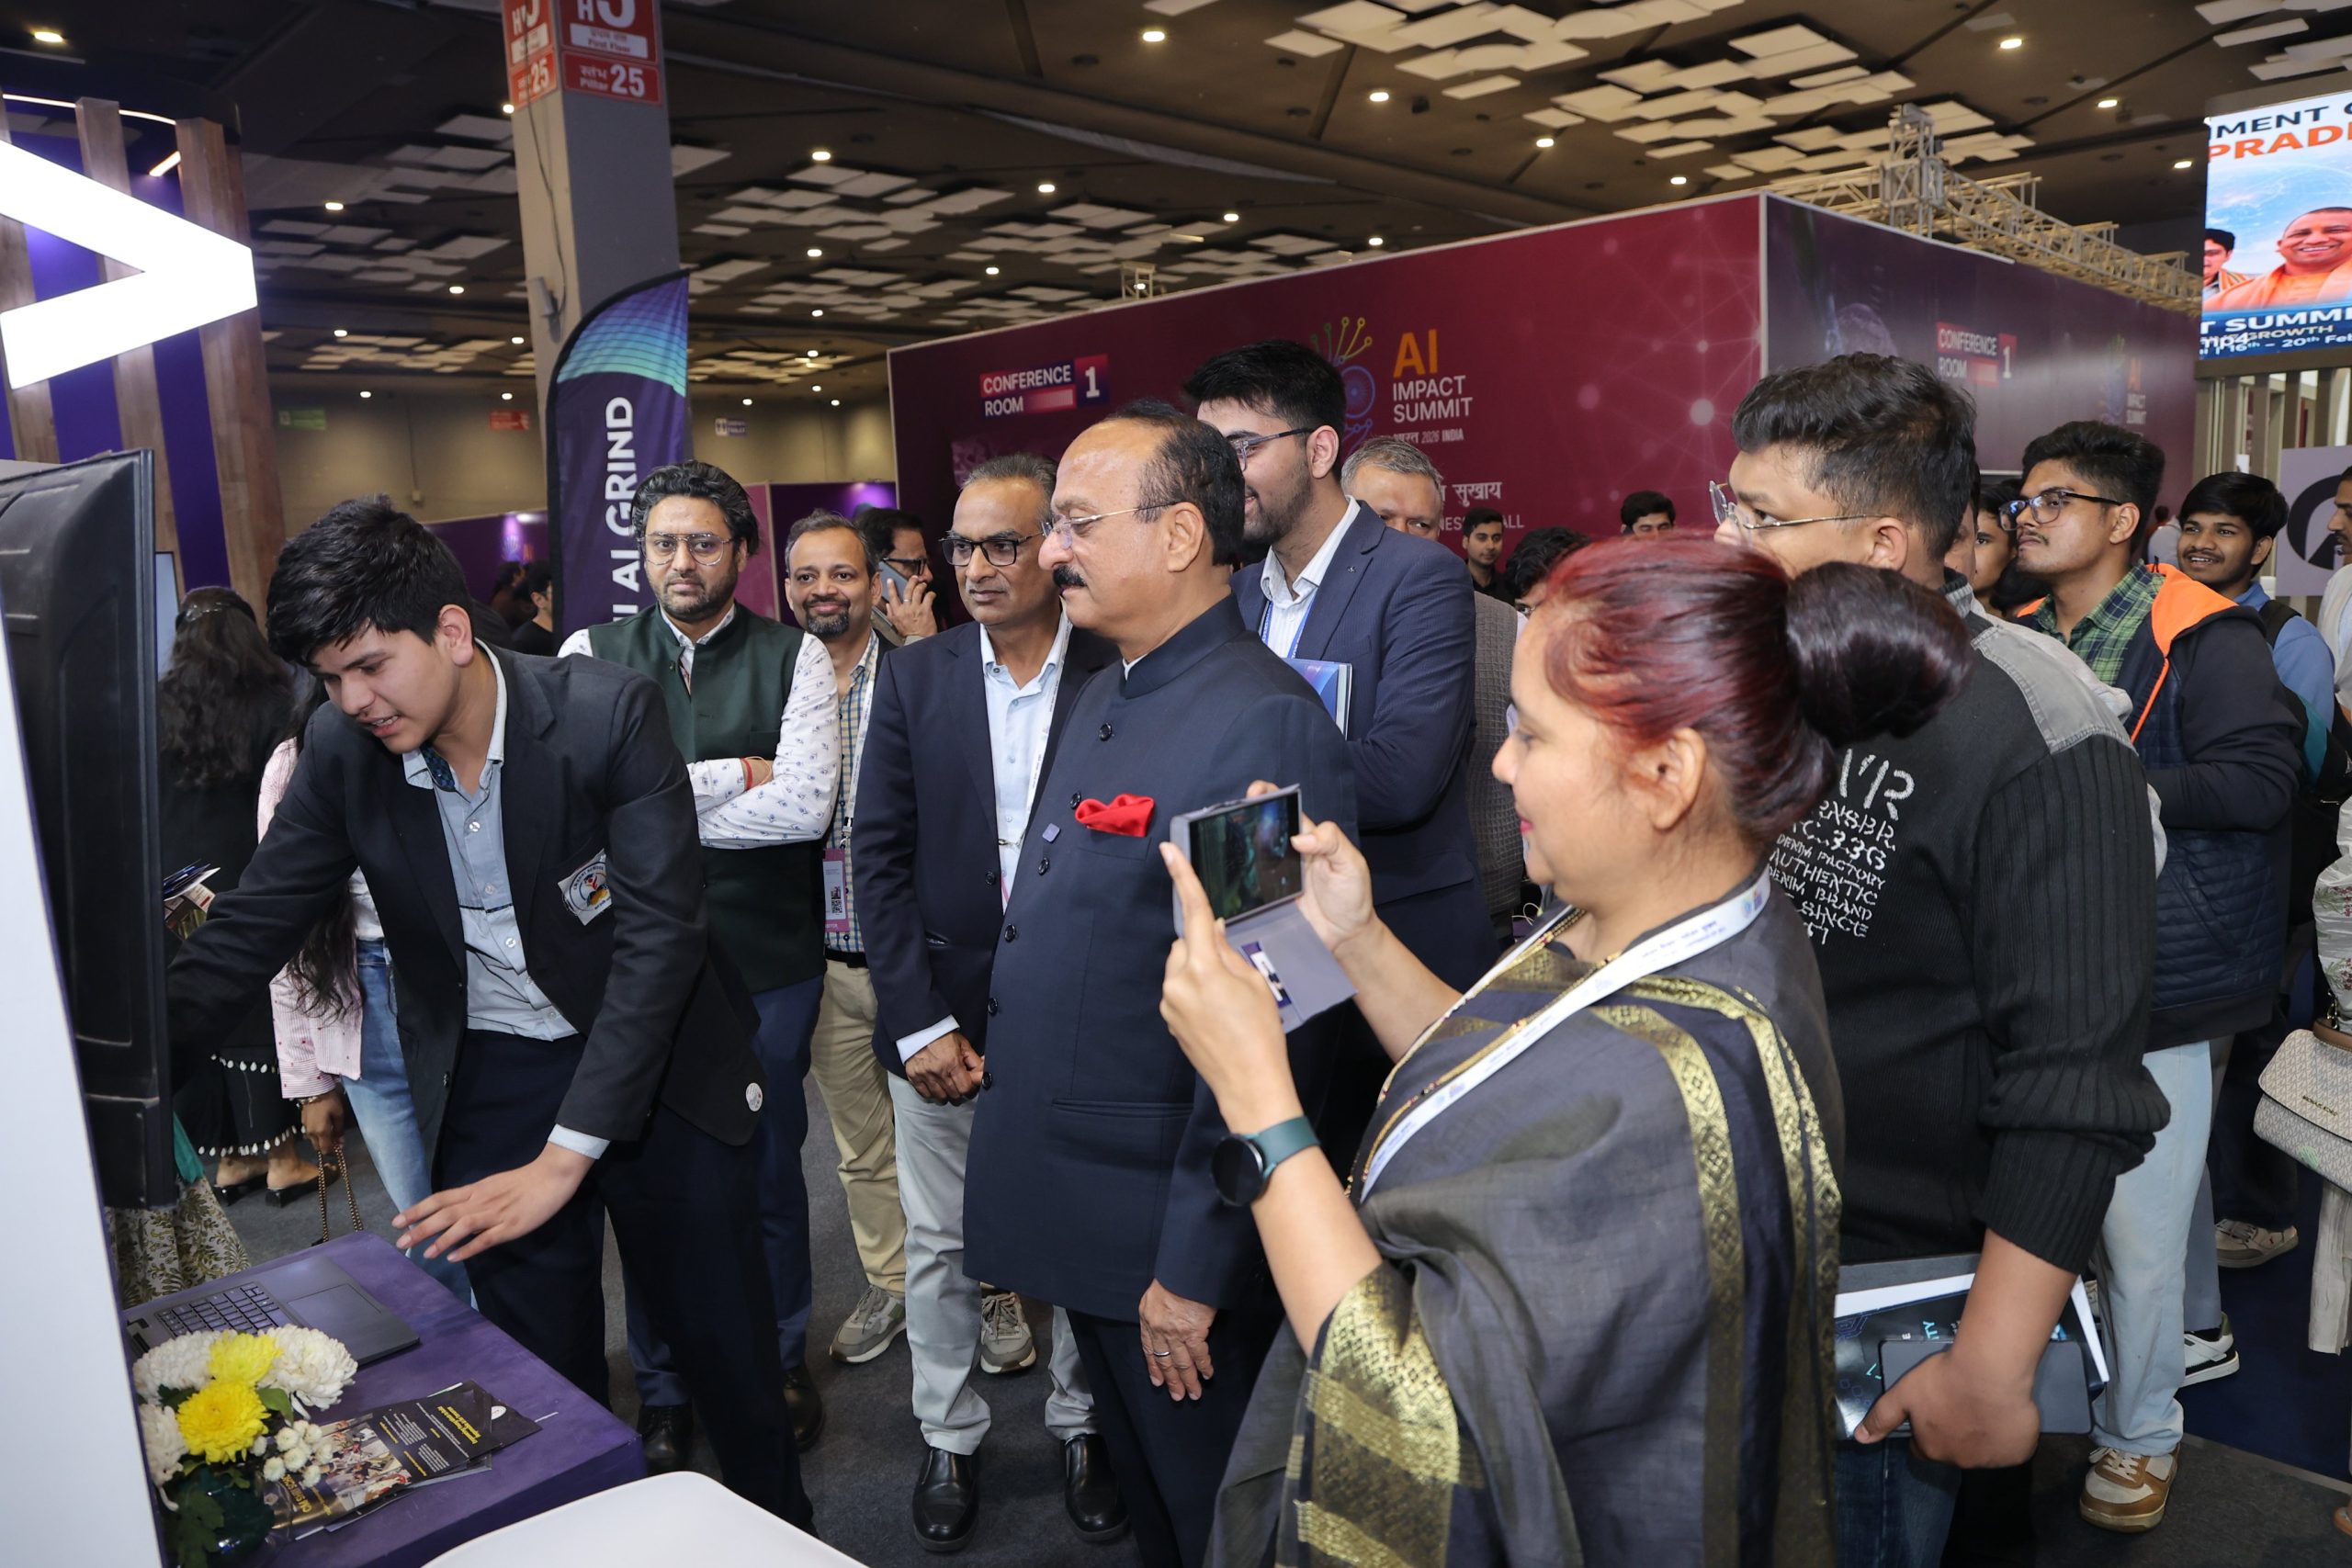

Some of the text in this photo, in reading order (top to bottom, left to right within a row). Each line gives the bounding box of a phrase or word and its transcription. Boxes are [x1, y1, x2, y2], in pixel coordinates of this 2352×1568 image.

[531, 59, 549, 93] 25
[611, 63, 645, 97] 25
[2208, 106, 2329, 139] MENT
[1393, 329, 1438, 378] AI
[1939, 329, 1997, 356] CONFERENCE
[1939, 356, 1967, 378] ROOM
[2002, 345, 2012, 379] 1
[983, 364, 1072, 394] CONFERENCE
[1085, 367, 1100, 399] 1
[1393, 375, 1466, 401] IMPACT
[984, 396, 1024, 417] ROOM
[1394, 397, 1473, 423] SUMMIT
[1442, 428, 1464, 442] INDIA
[605, 397, 639, 536] GRIND
[1452, 481, 1503, 507] सुखाय
[611, 549, 640, 592] AI
[1769, 847, 1878, 906] AUTHENTIC
